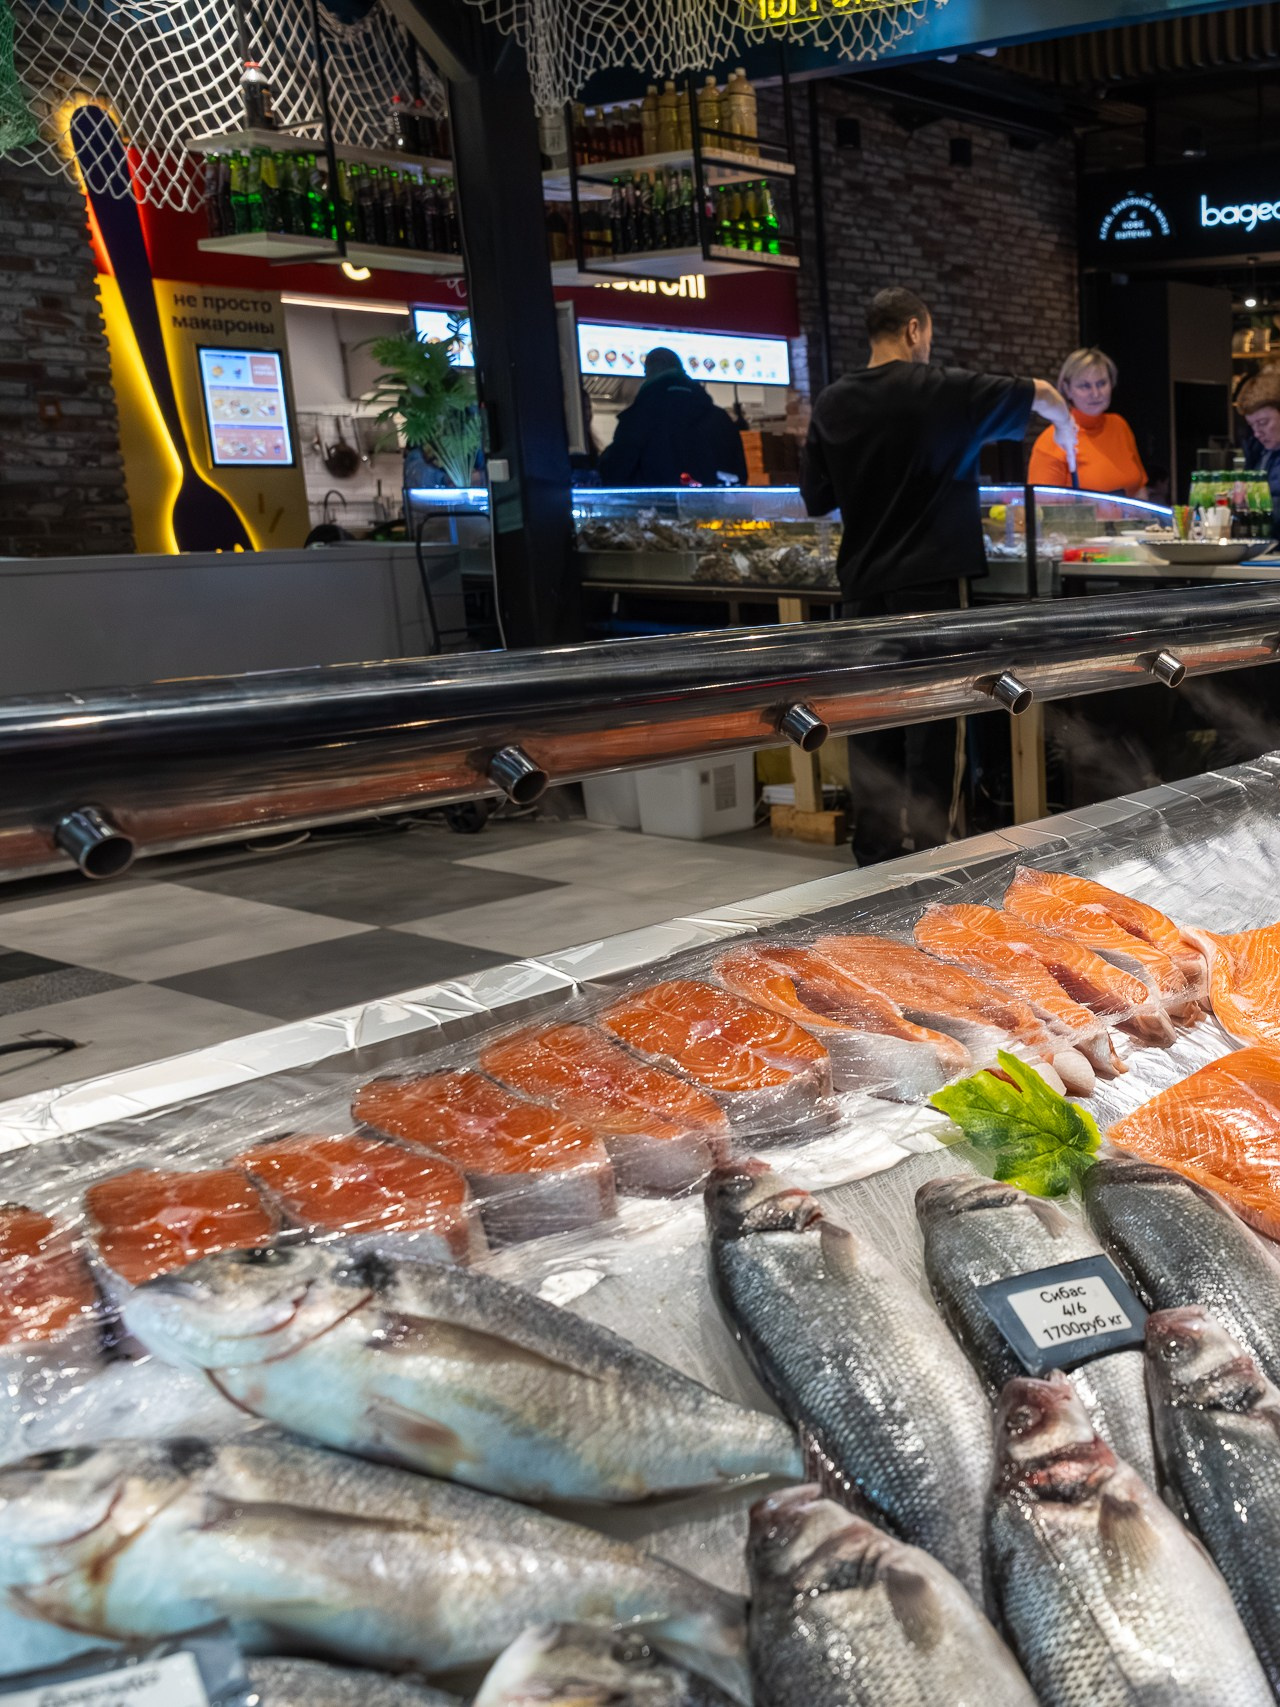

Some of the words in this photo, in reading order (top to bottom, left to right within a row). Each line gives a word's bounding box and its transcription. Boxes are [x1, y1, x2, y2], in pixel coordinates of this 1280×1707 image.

[173, 294, 197, 308] не
[203, 296, 272, 314] просто
[171, 315, 275, 336] макароны
[1040, 1286, 1086, 1303] Сибас
[1062, 1302, 1087, 1316] 4/6
[1043, 1315, 1106, 1341] 1700руб
[1108, 1314, 1123, 1327] кг
